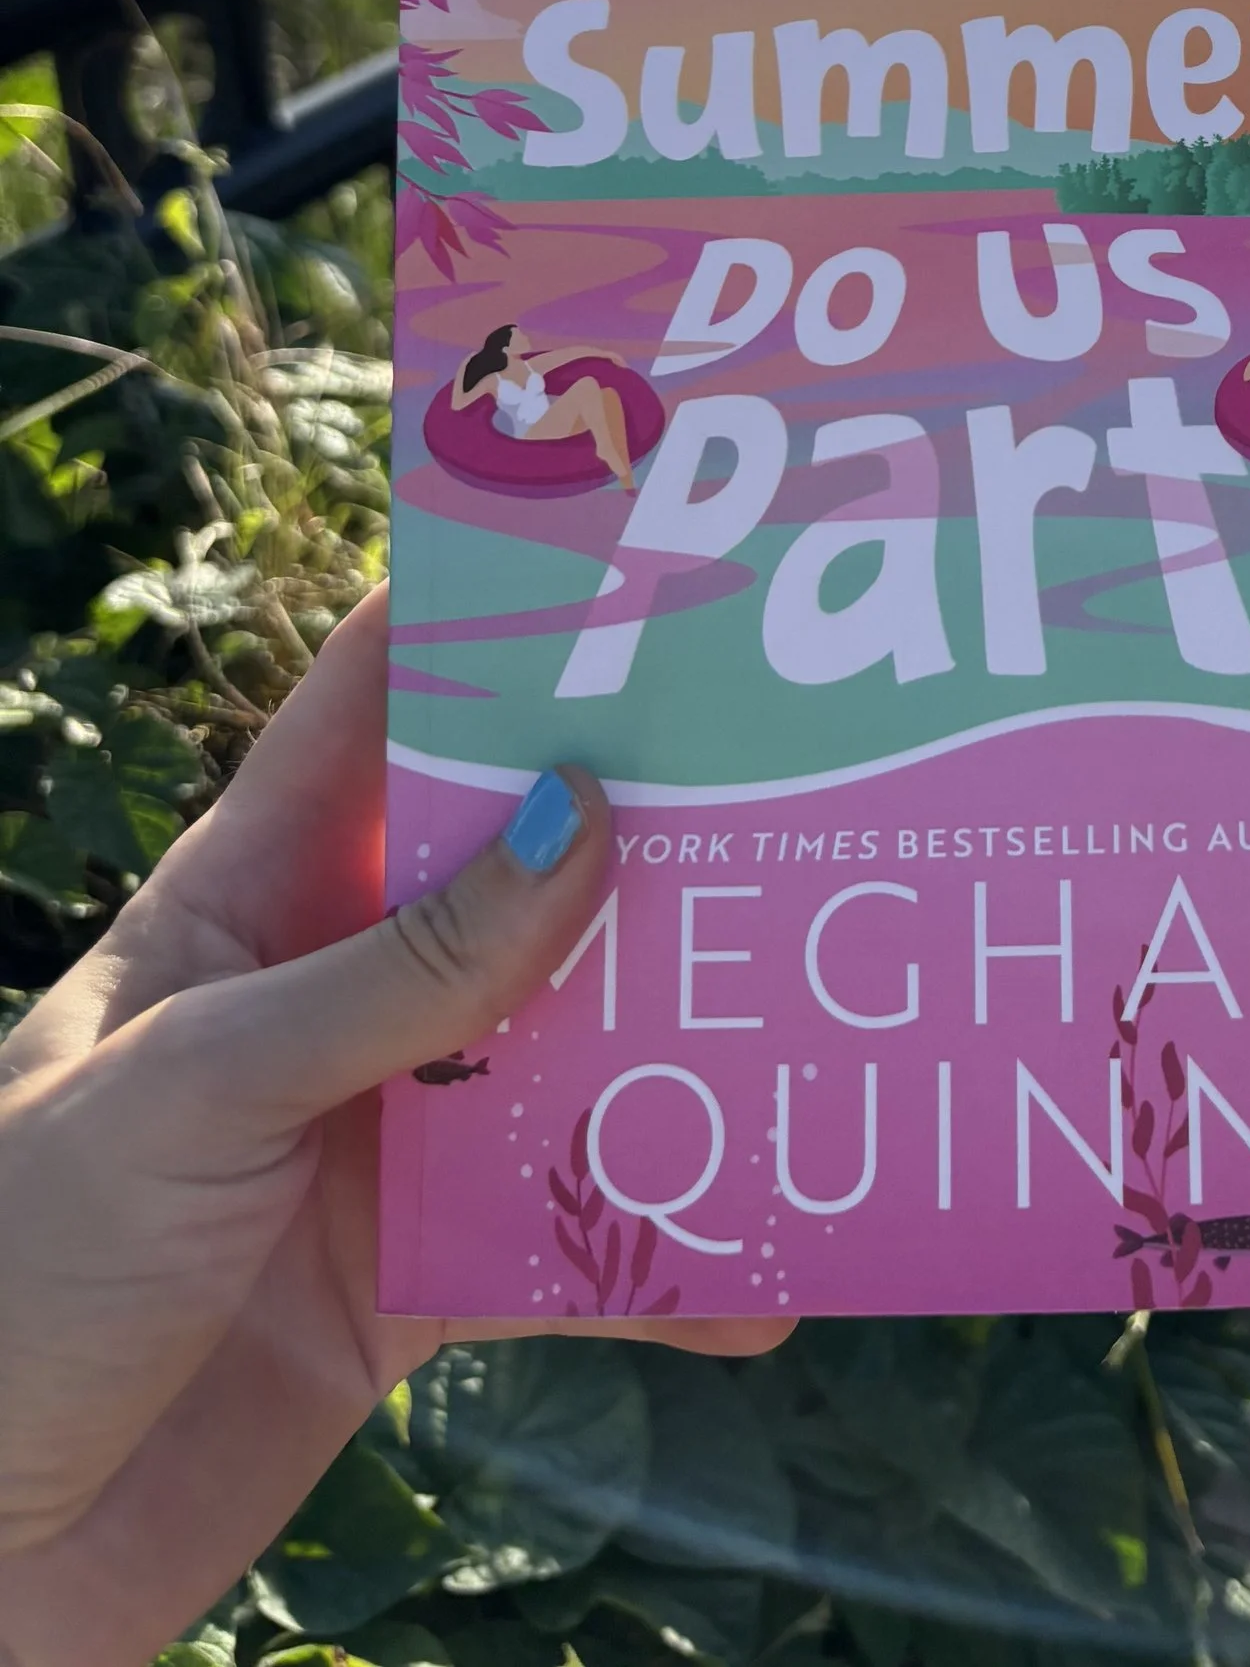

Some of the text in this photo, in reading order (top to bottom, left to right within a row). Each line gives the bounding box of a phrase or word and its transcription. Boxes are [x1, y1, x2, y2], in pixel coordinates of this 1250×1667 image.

[616, 833, 735, 865] YORK
[753, 829, 880, 864] TIMES
[897, 822, 1190, 860] BESTSELLING
